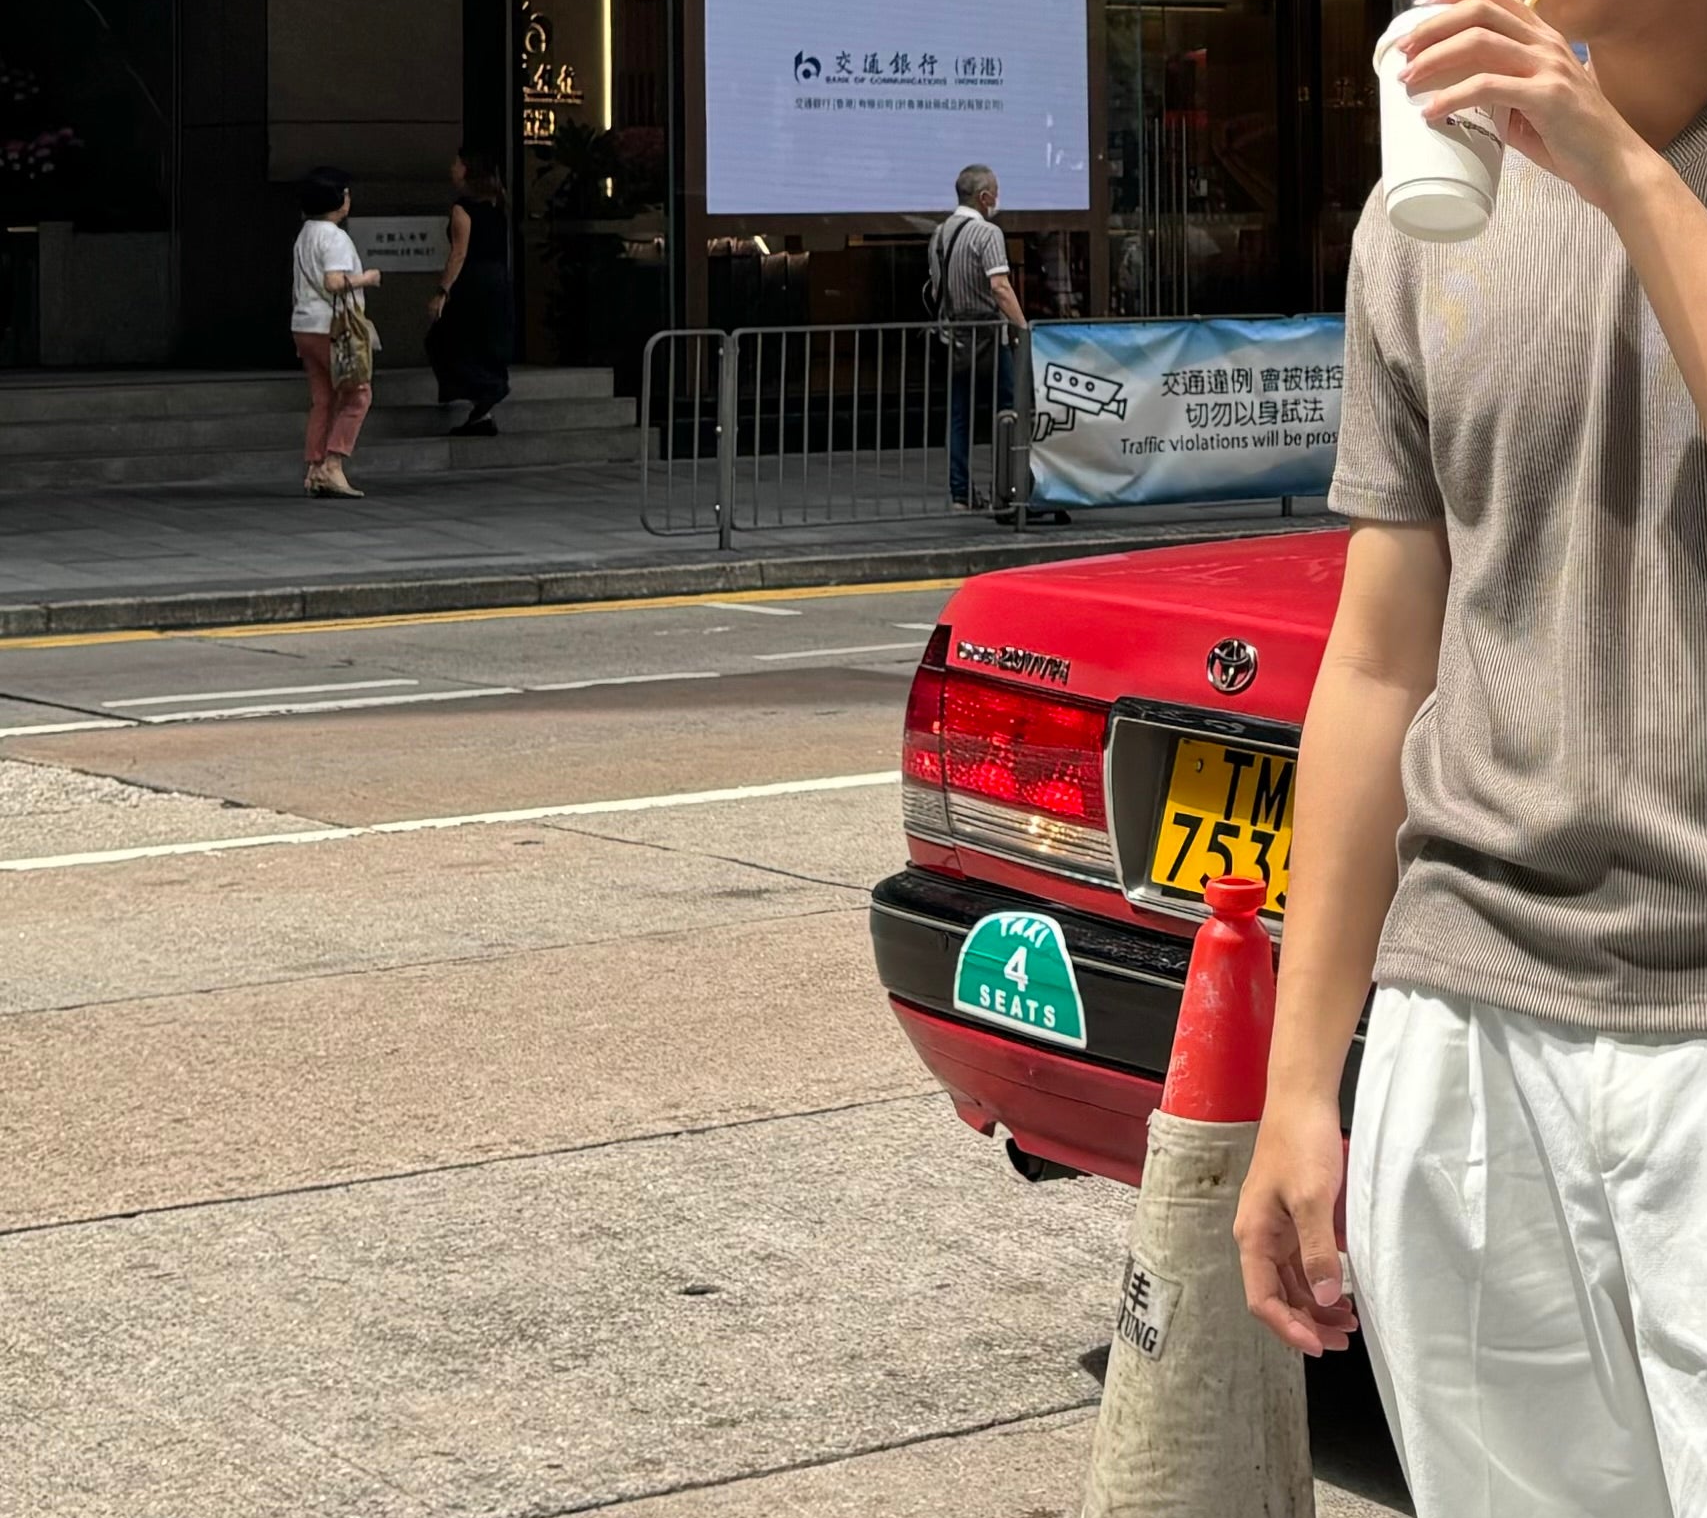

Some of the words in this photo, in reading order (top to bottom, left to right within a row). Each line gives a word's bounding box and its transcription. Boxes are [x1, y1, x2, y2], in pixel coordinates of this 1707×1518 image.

[835, 50, 938, 76] 交通銀行
[1161, 368, 1253, 397] 交通違例
[1186, 398, 1326, 429] 切勿以身試法
[1121, 435, 1165, 456] Traffic
[1168, 433, 1249, 452] violations
[1253, 430, 1279, 448] will
[1283, 429, 1302, 446] be
[1223, 748, 1295, 831] TM
[998, 916, 1051, 949] TAXI
[1003, 945, 1029, 993] 4
[979, 984, 1056, 1029] SEATS
